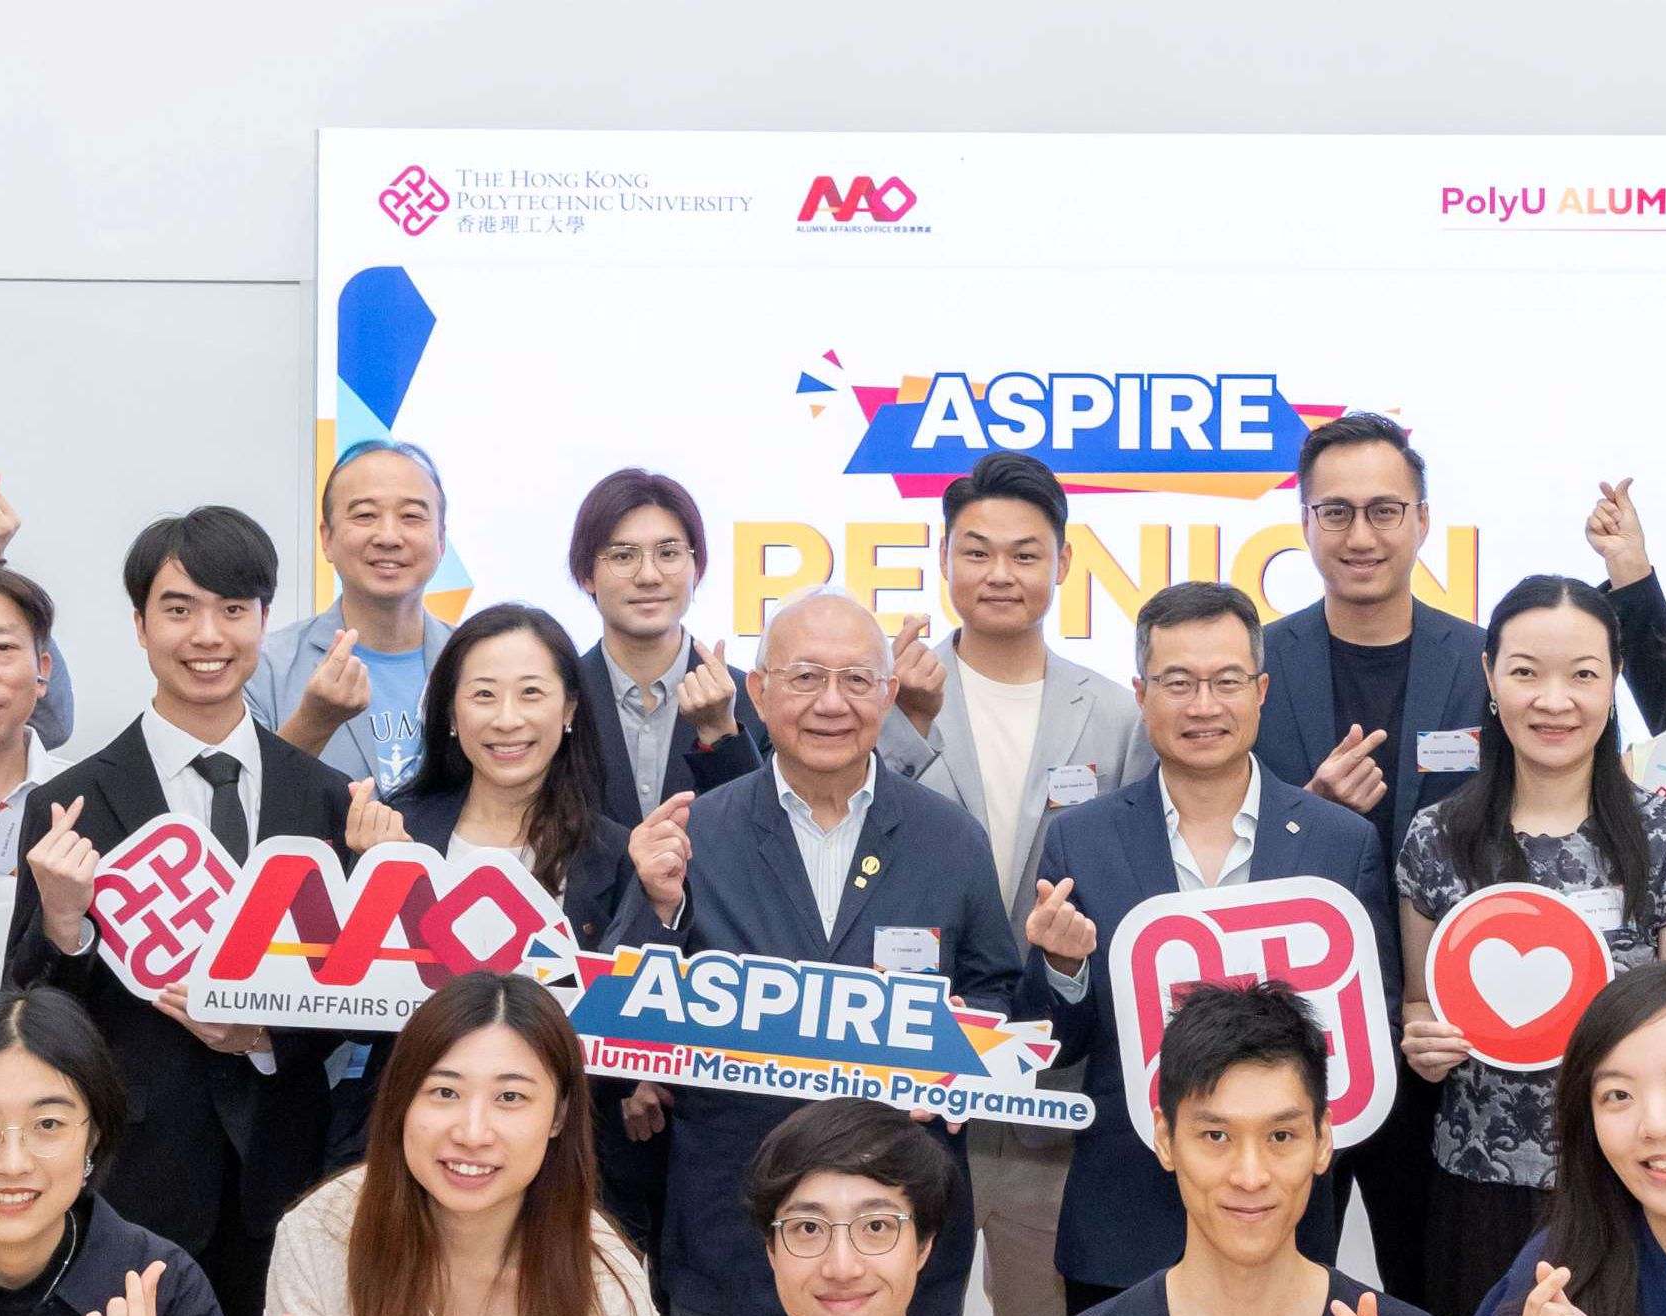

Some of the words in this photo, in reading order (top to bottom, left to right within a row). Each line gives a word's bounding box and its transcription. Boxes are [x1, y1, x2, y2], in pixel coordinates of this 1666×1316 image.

[456, 168, 503, 188] THE
[510, 169, 579, 189] HONG
[585, 170, 649, 189] KONG
[456, 192, 614, 211] POLYTECHNIC
[619, 193, 753, 213] UNIVERSITY
[1441, 186, 1546, 222] PolyU
[456, 214, 586, 235] 香港理工大學
[910, 374, 1275, 451] ASPIRE
[204, 990, 291, 1012] ALUMNI
[296, 994, 389, 1017] AFFAIRS
[619, 954, 938, 1052] ASPIRE
[692, 1052, 883, 1102] Mentorship
[890, 1076, 1088, 1123] Programme
